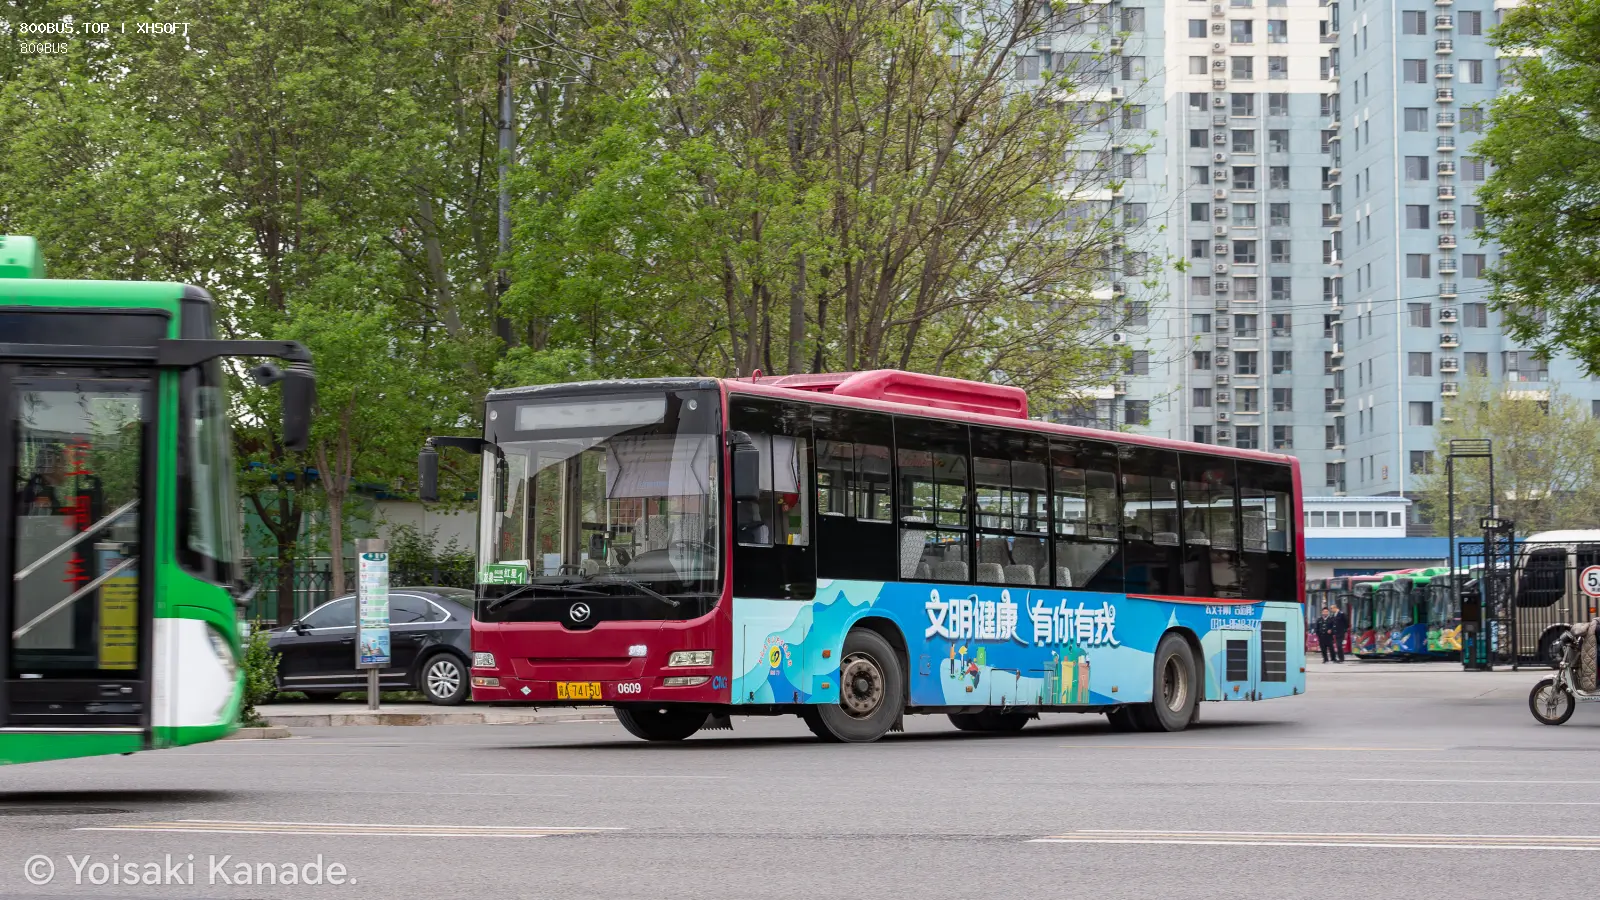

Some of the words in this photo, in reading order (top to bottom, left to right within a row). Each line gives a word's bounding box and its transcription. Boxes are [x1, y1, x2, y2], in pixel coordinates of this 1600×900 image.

[925, 589, 1029, 645] 文明健康
[1026, 590, 1121, 647] 有你有我
[617, 682, 642, 695] 0609
[712, 675, 728, 690] CNG
